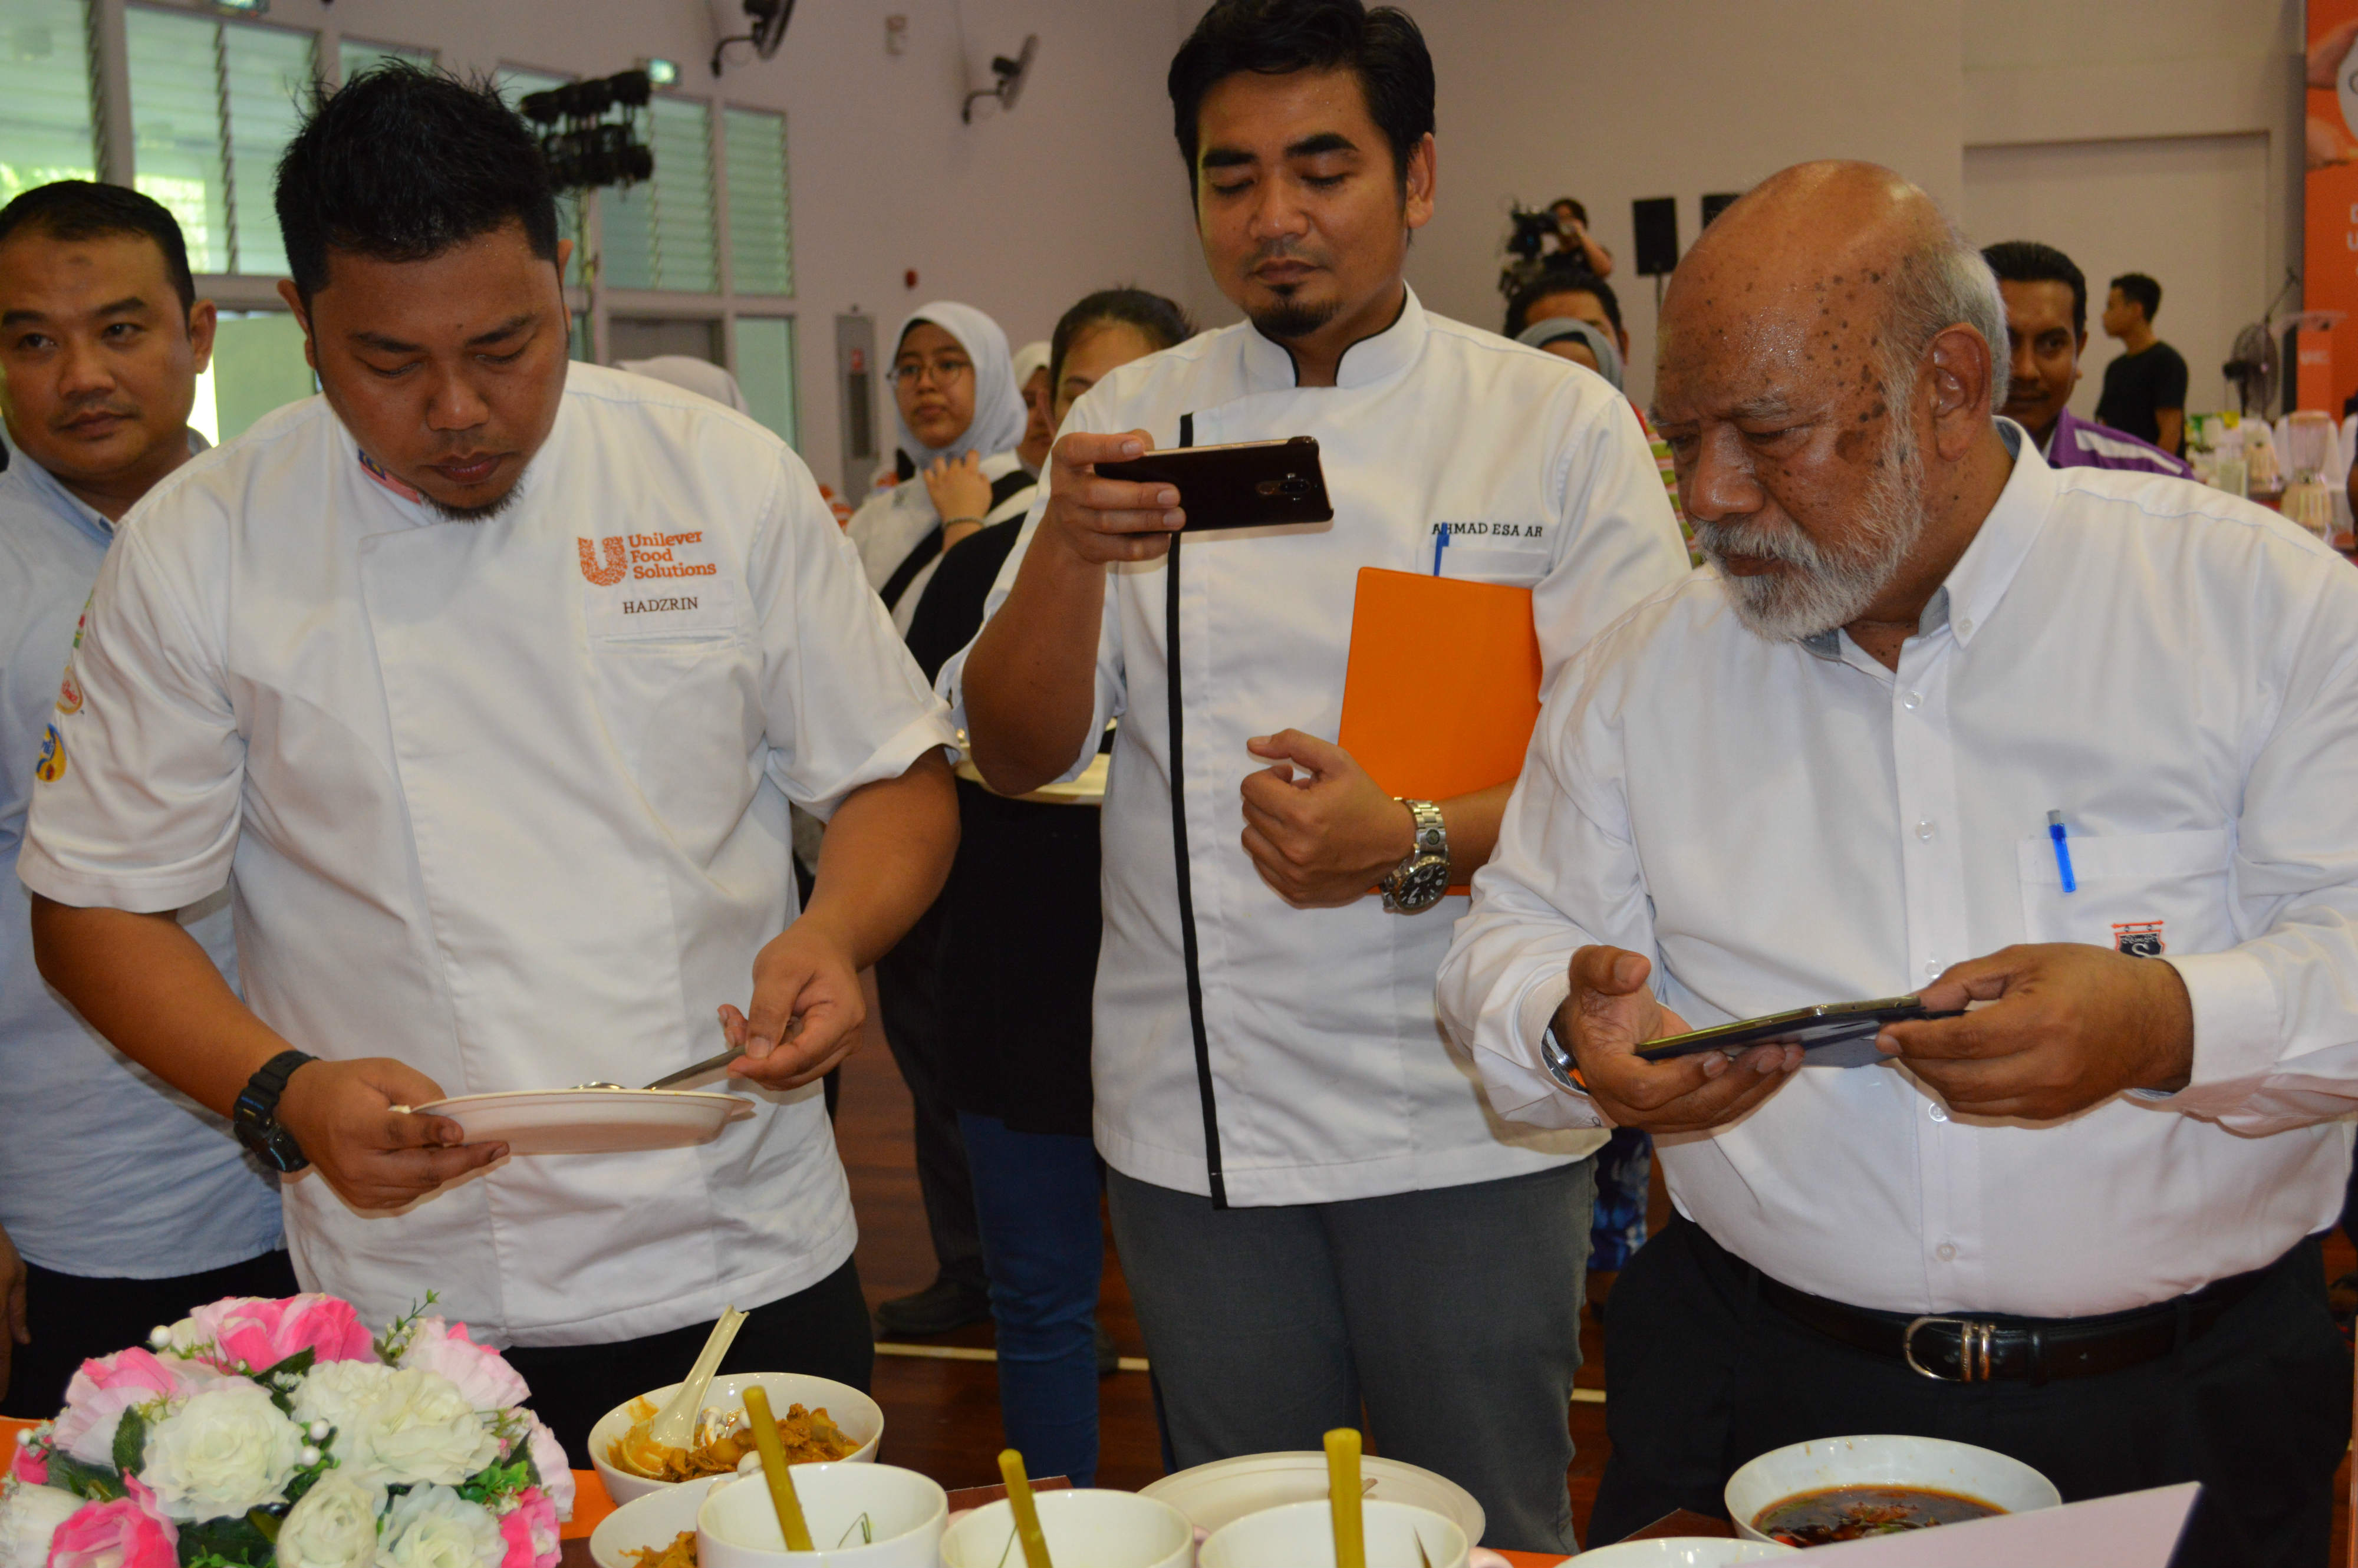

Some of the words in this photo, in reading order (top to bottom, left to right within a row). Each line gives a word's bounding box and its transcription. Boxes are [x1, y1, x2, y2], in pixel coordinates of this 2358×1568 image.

[1492, 523, 1520, 536] ESA
[1524, 526, 1543, 537] AR
[628, 531, 702, 548] Unilever
[630, 548, 674, 563] Food
[633, 562, 717, 579] Solutions
[623, 597, 698, 614] HADZRIN
